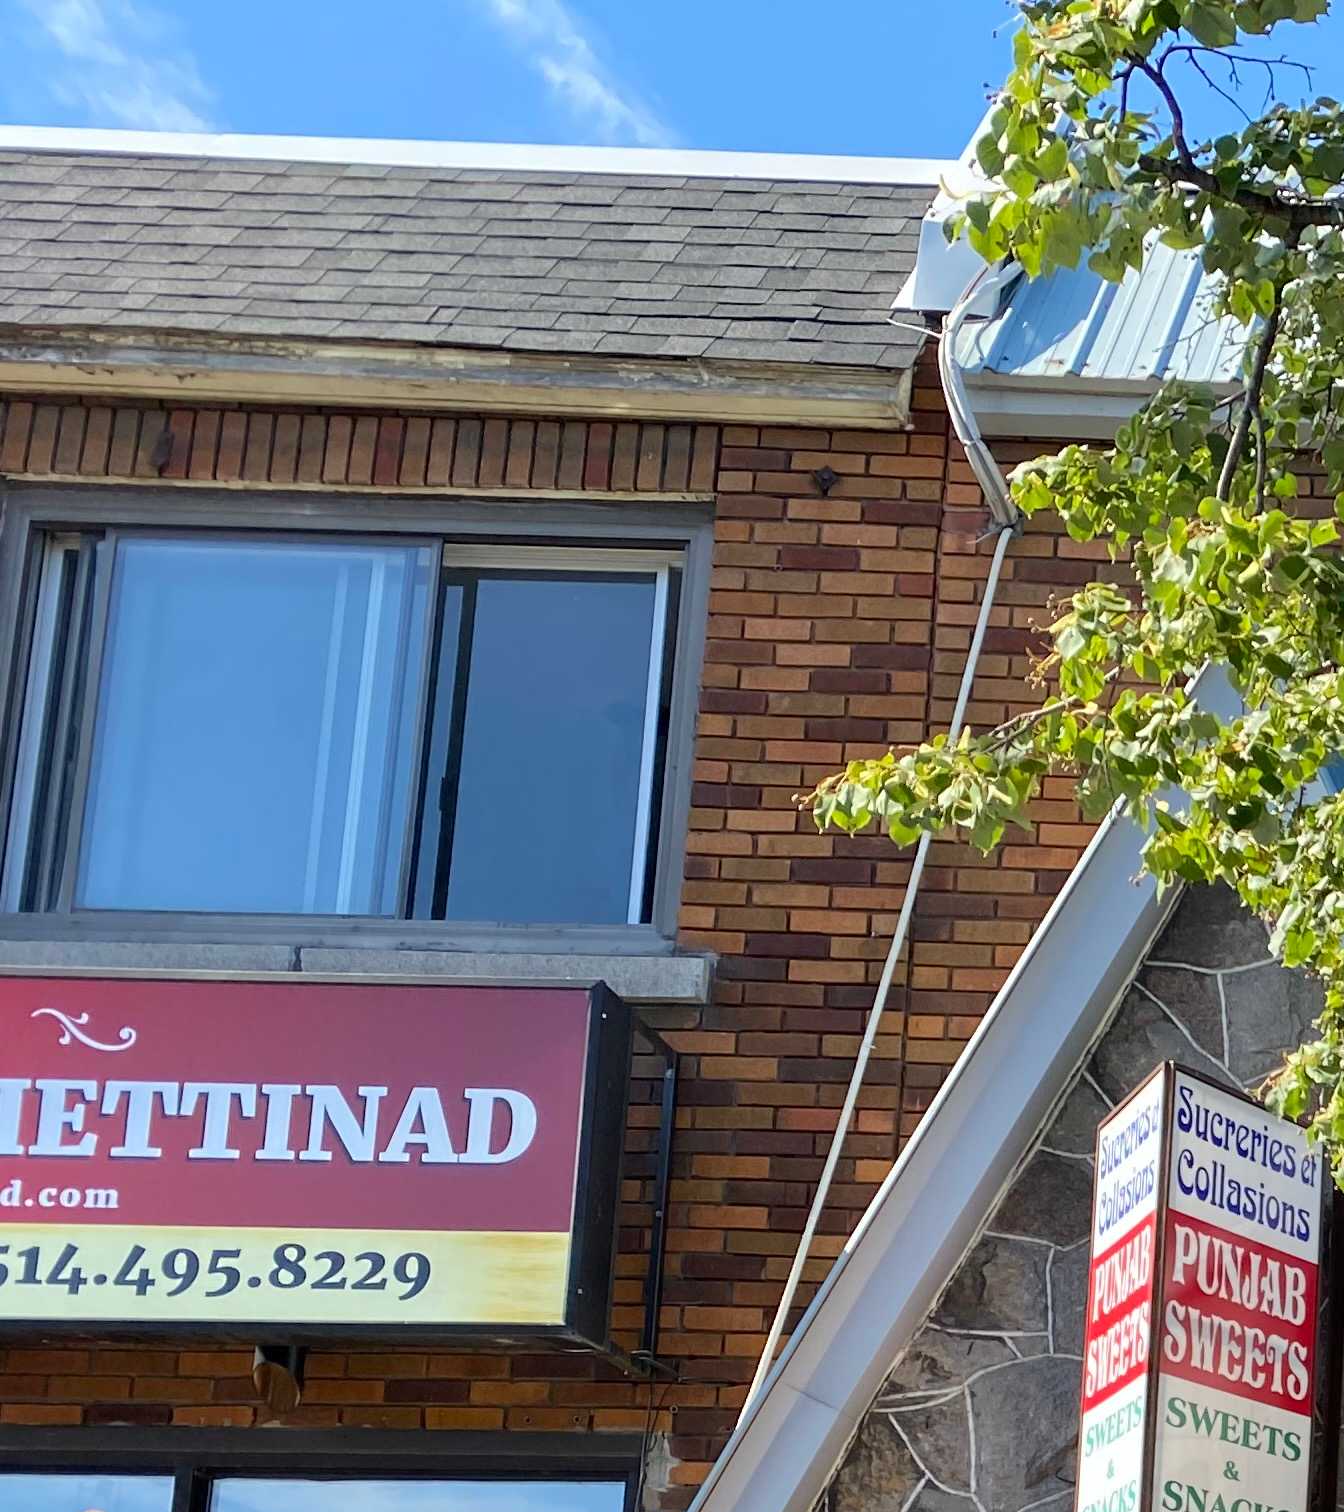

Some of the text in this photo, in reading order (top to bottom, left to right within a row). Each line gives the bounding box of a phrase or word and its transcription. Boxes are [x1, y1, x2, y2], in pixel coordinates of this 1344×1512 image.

[1177, 1085, 1317, 1188] Sucreries et
[1098, 1157, 1155, 1237] Collasions
[1176, 1149, 1311, 1243] Collasions
[1092, 1223, 1152, 1324] PUNJAB
[1172, 1222, 1307, 1327] PUNJAB
[1085, 1300, 1150, 1400] SWEETS
[1163, 1299, 1310, 1402] SWEETS
[1085, 1395, 1143, 1458] SWEETS
[1106, 1458, 1115, 1480] &
[1166, 1396, 1302, 1462] SWEETS
[1223, 1460, 1241, 1482] &
